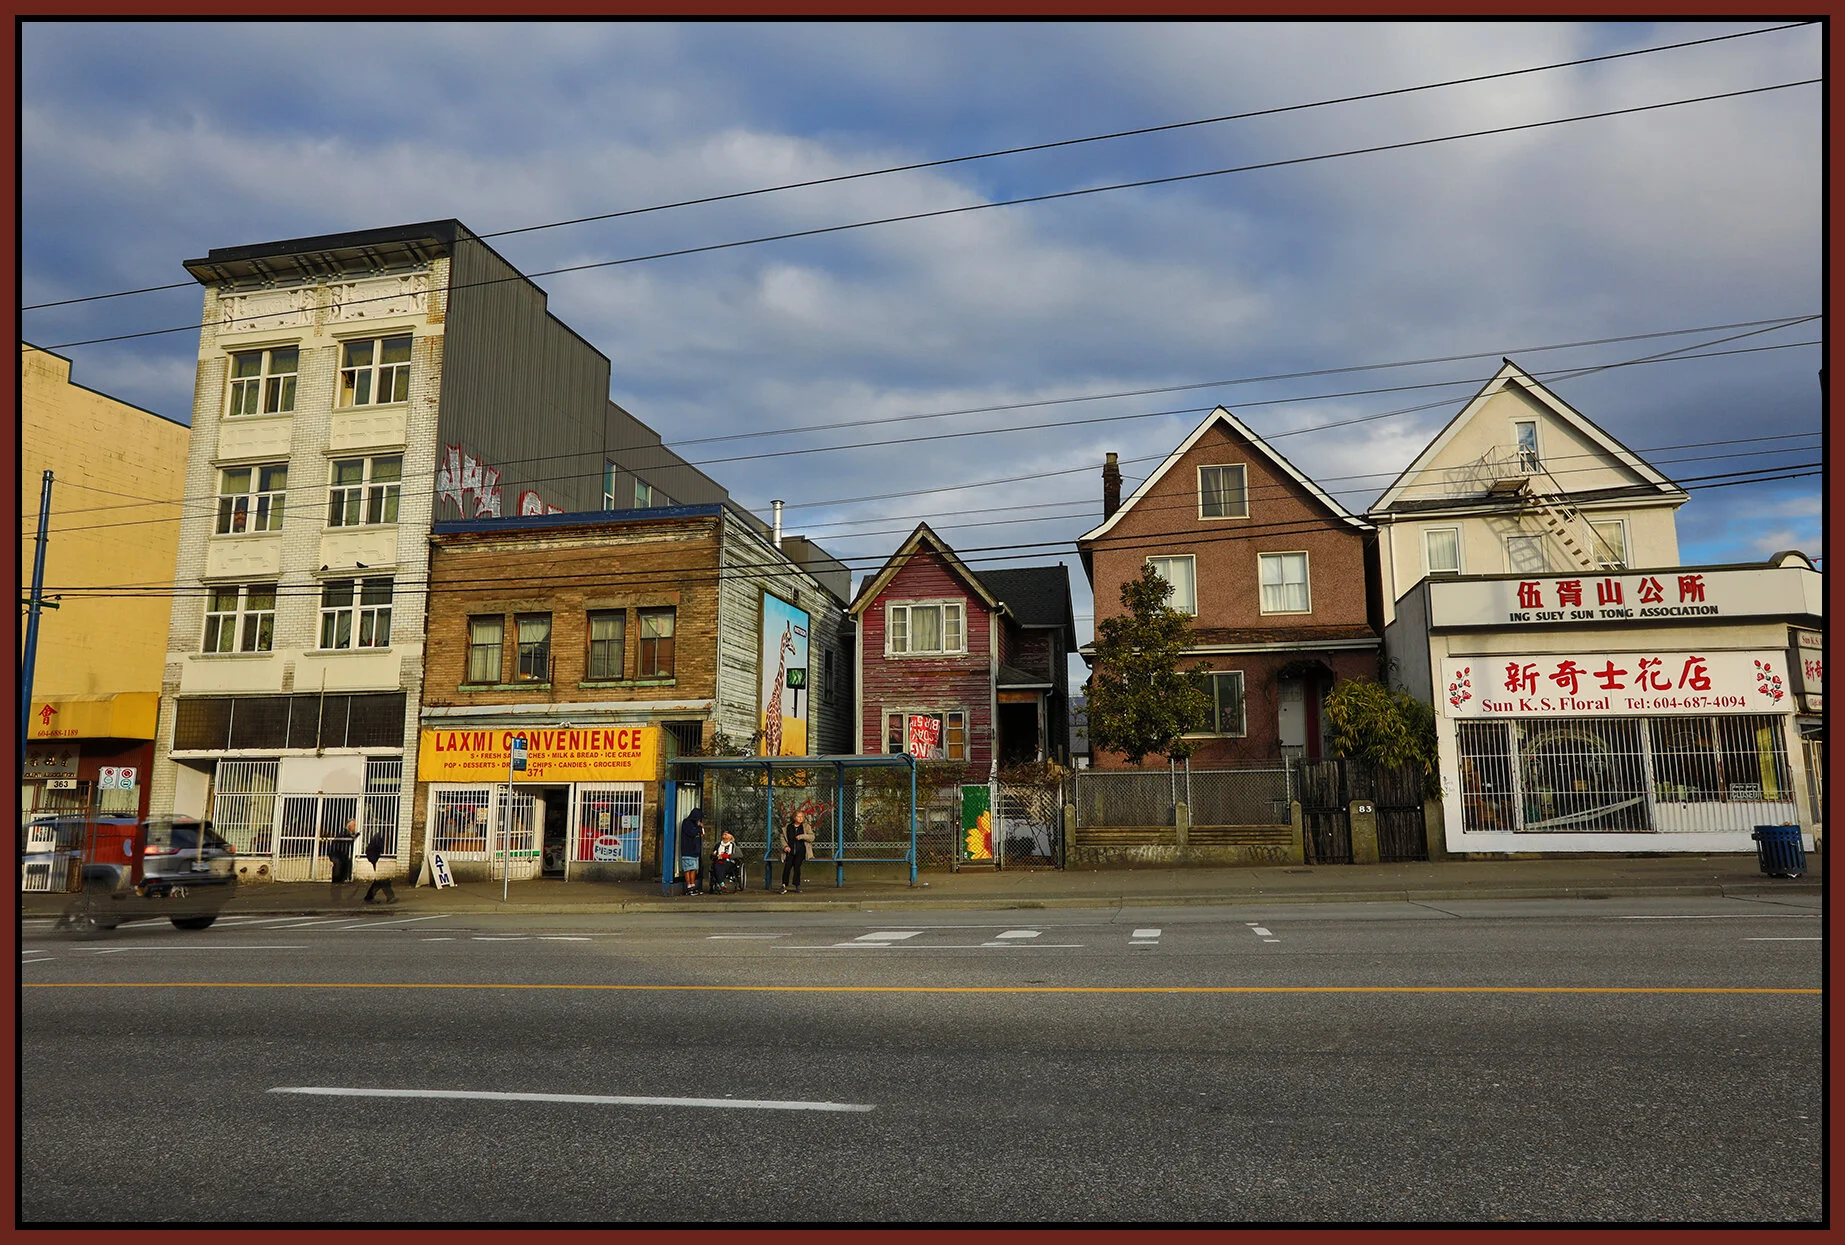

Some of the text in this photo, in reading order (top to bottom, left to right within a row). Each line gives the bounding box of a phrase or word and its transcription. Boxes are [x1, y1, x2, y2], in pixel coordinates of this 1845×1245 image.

[1517, 574, 1706, 609] 伍胥山公所
[1510, 605, 1719, 622] ING SUEY SUN TONG ASSOCIATION
[1504, 656, 1711, 696] 新奇士花店
[1482, 699, 1513, 712] Sun
[1560, 697, 1610, 711] Floral
[435, 731, 493, 752] LAXMI
[527, 768, 543, 777] 371
[53, 780, 69, 788] 363
[1358, 805, 1372, 813] 83
[435, 854, 450, 884] ATM
